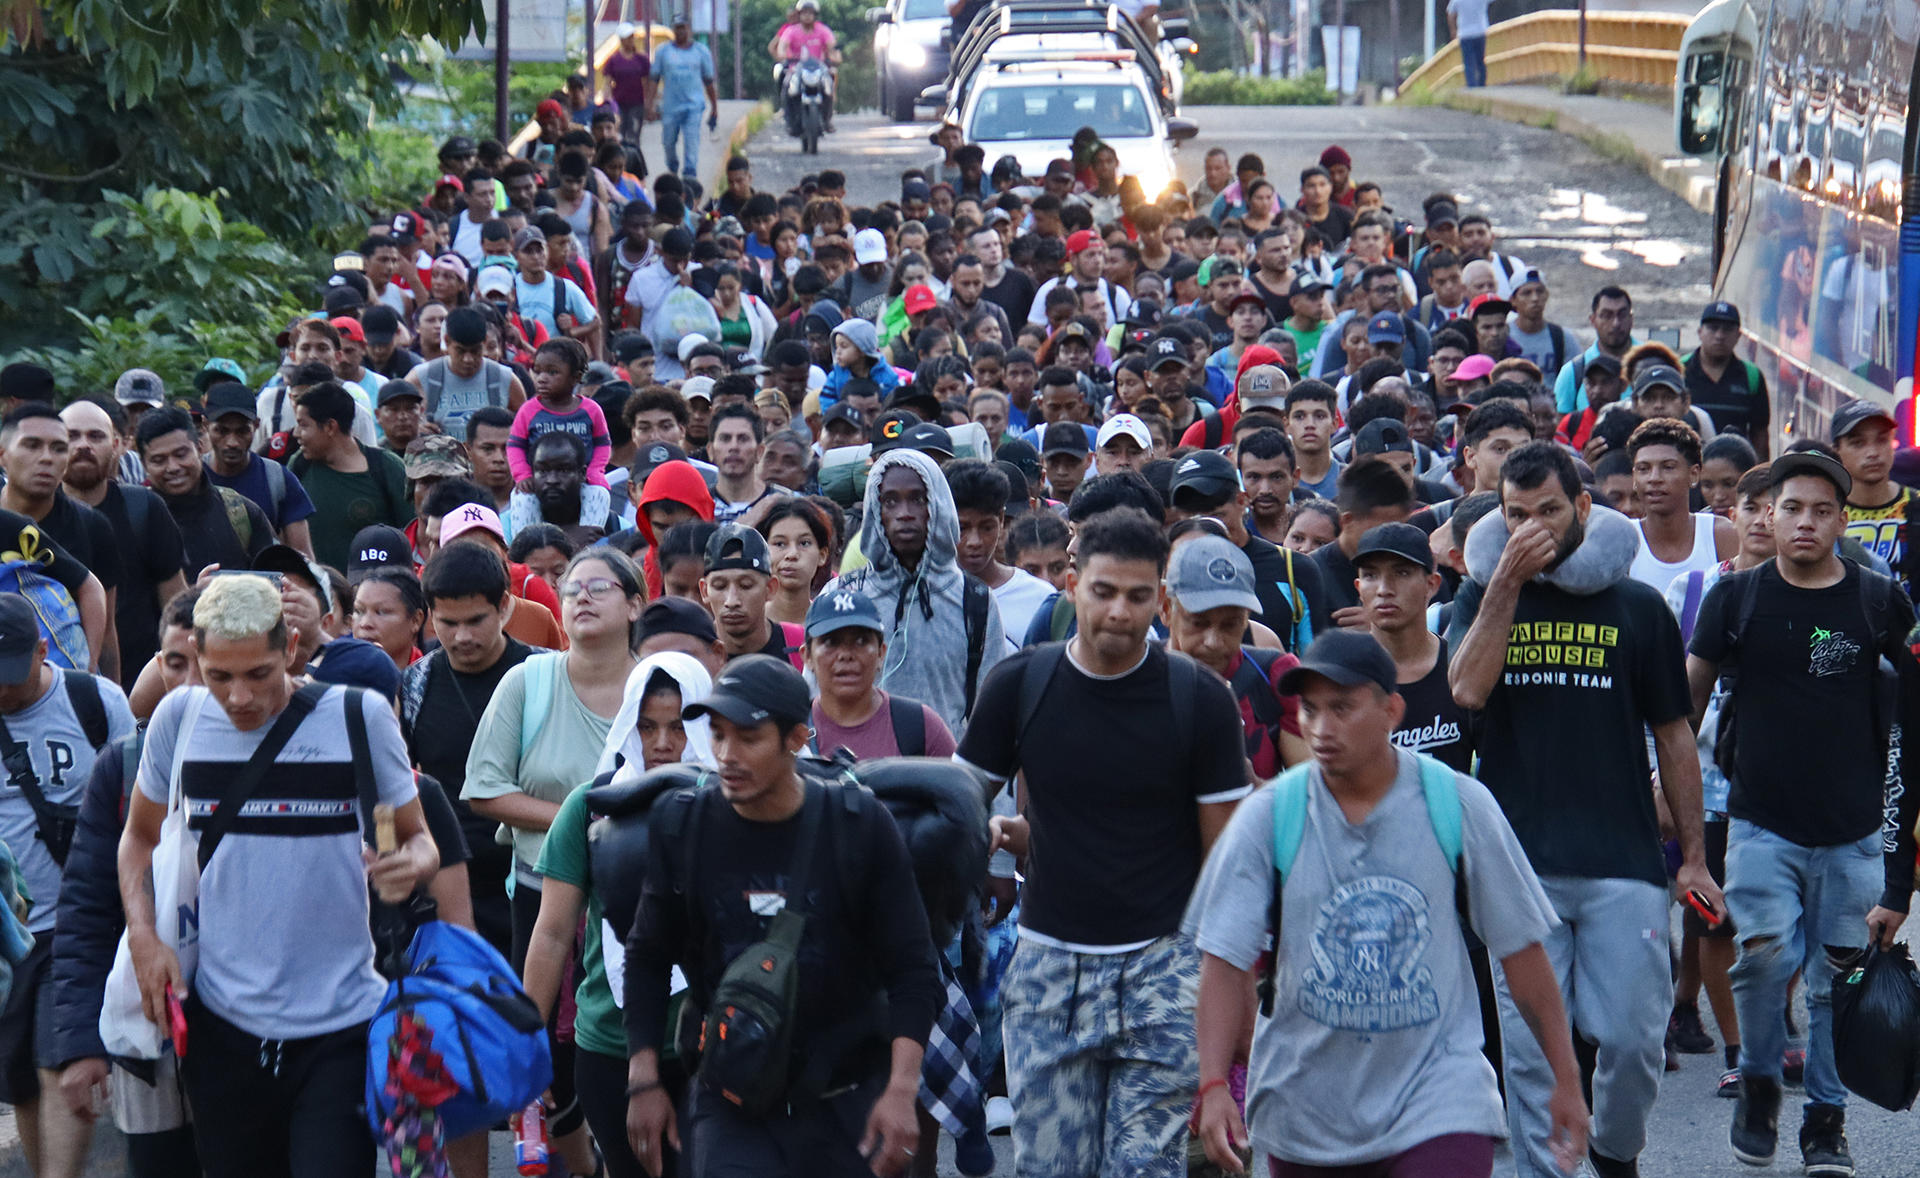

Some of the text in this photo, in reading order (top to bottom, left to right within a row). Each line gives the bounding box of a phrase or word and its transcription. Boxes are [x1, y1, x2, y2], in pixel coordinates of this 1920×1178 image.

[566, 422, 587, 434] PWR
[464, 507, 484, 521] NY
[361, 548, 388, 561] ABC
[833, 593, 856, 611] NY
[1507, 645, 1605, 668] HOUSE
[1573, 674, 1612, 689] TEAM
[1389, 714, 1459, 750] ngeles
[290, 802, 339, 813] TOMMY
[1357, 943, 1381, 972] NY
[1314, 984, 1368, 1004] WORLD
[1300, 986, 1438, 1029] CHAMPIONS
